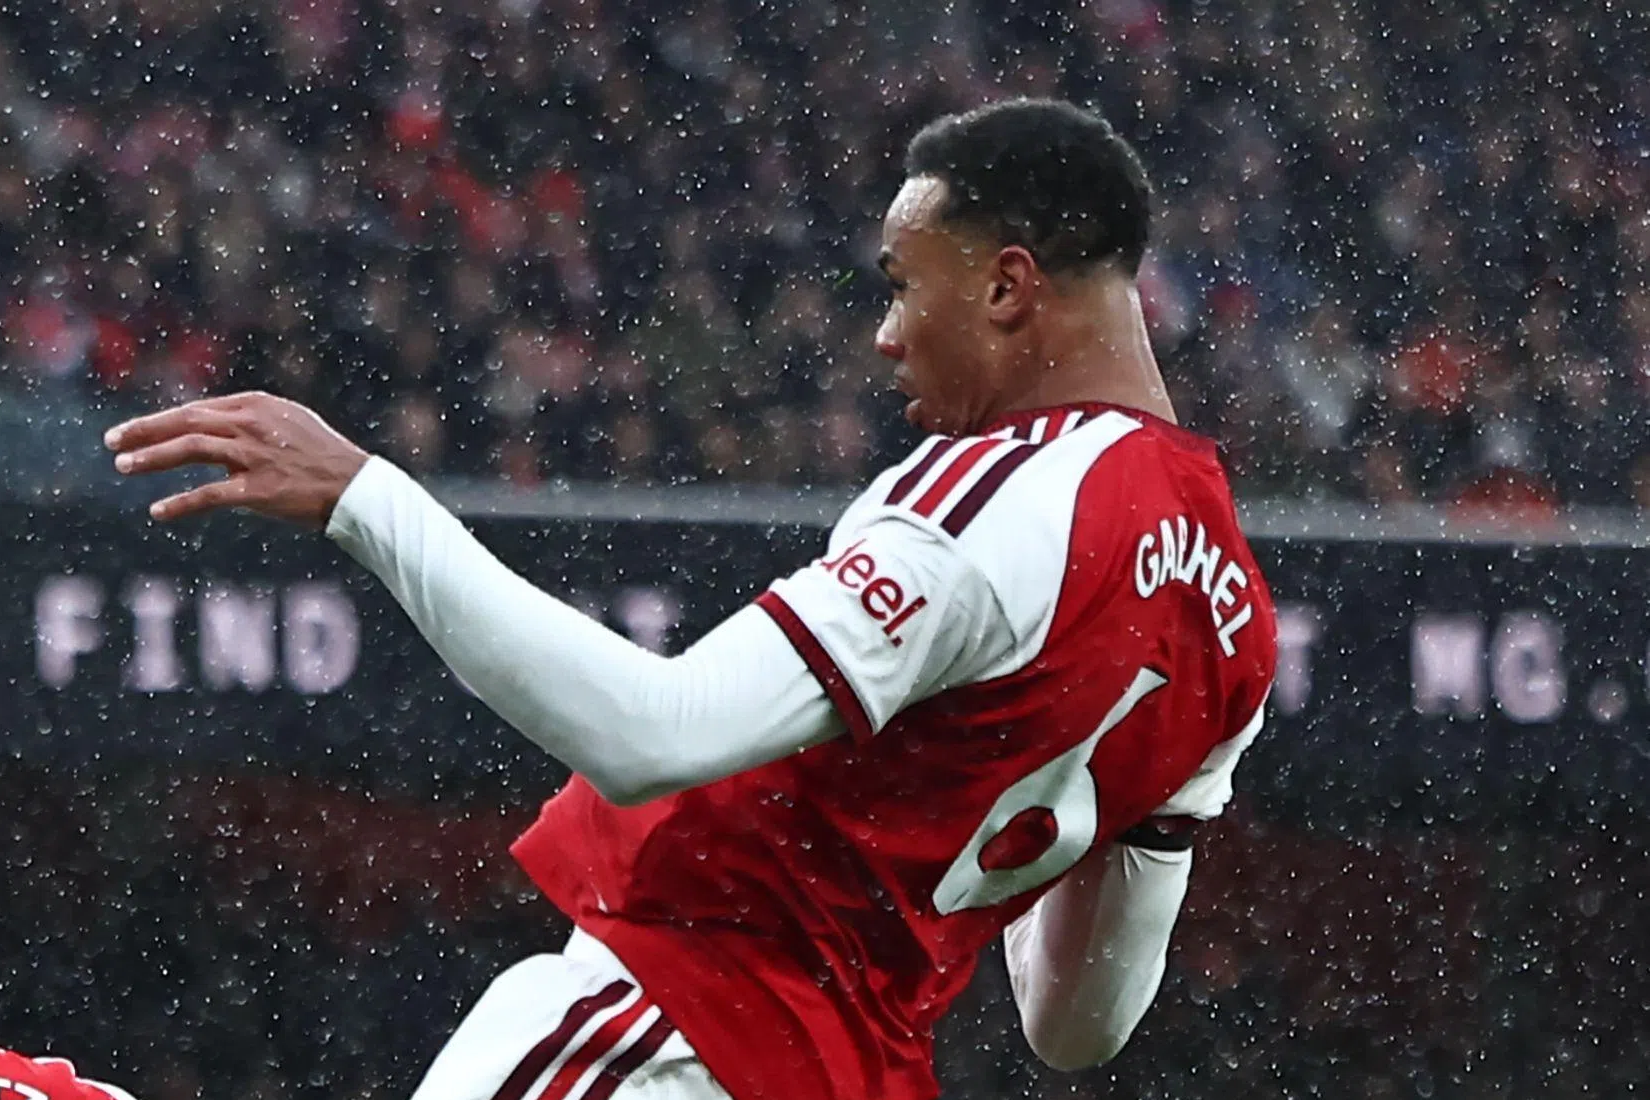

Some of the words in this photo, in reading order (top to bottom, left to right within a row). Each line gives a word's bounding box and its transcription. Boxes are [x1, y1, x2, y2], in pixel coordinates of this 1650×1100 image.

[34, 575, 360, 693] FIND
[1410, 611, 1630, 724] MG.
[932, 665, 1168, 915] 6
